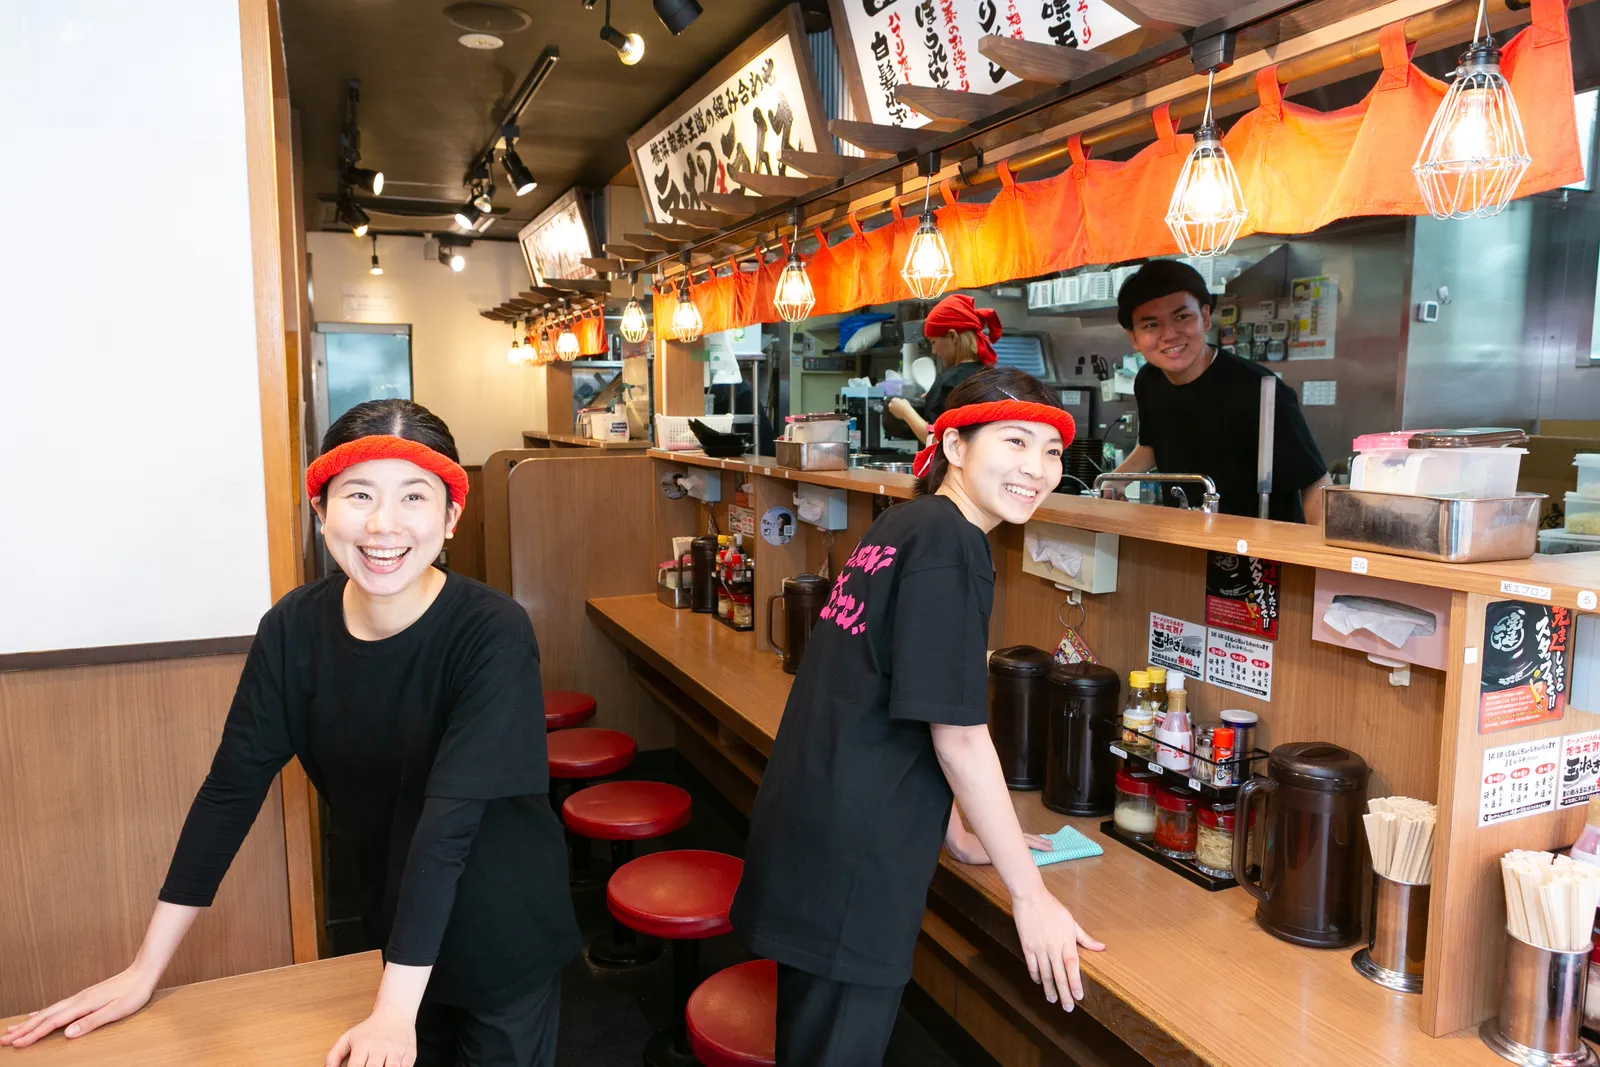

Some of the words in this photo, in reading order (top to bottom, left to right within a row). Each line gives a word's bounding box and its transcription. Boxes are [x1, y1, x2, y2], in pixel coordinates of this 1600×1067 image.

[650, 58, 776, 166] 横浜家系王道の組み合わせ
[1503, 583, 1549, 597] 紙エプロン
[1584, 596, 1590, 604] 5
